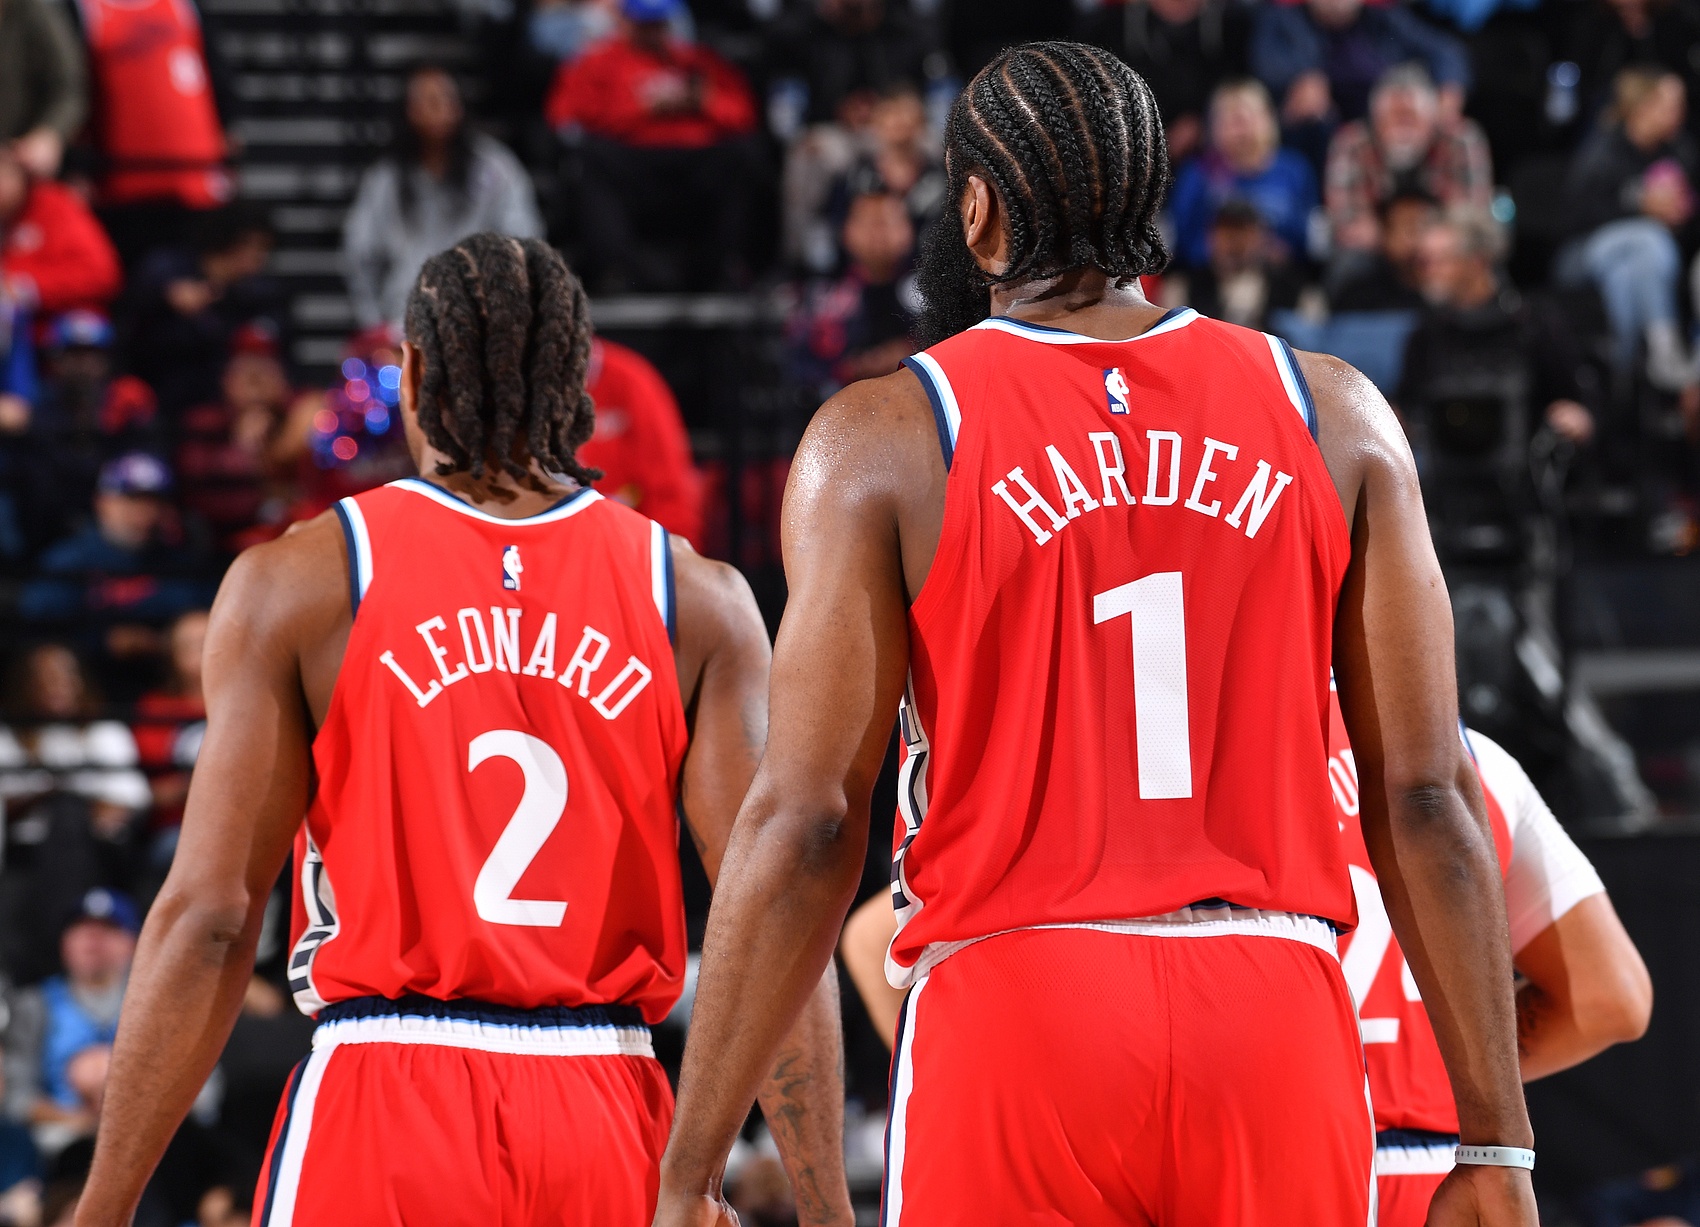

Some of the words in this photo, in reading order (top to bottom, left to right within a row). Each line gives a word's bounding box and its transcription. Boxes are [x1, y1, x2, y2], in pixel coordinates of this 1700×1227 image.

[991, 430, 1293, 547] HARDEN
[379, 606, 652, 720] LEONARD
[1093, 572, 1193, 800] 1
[467, 730, 569, 927] 2
[1340, 863, 1423, 1044] 2
